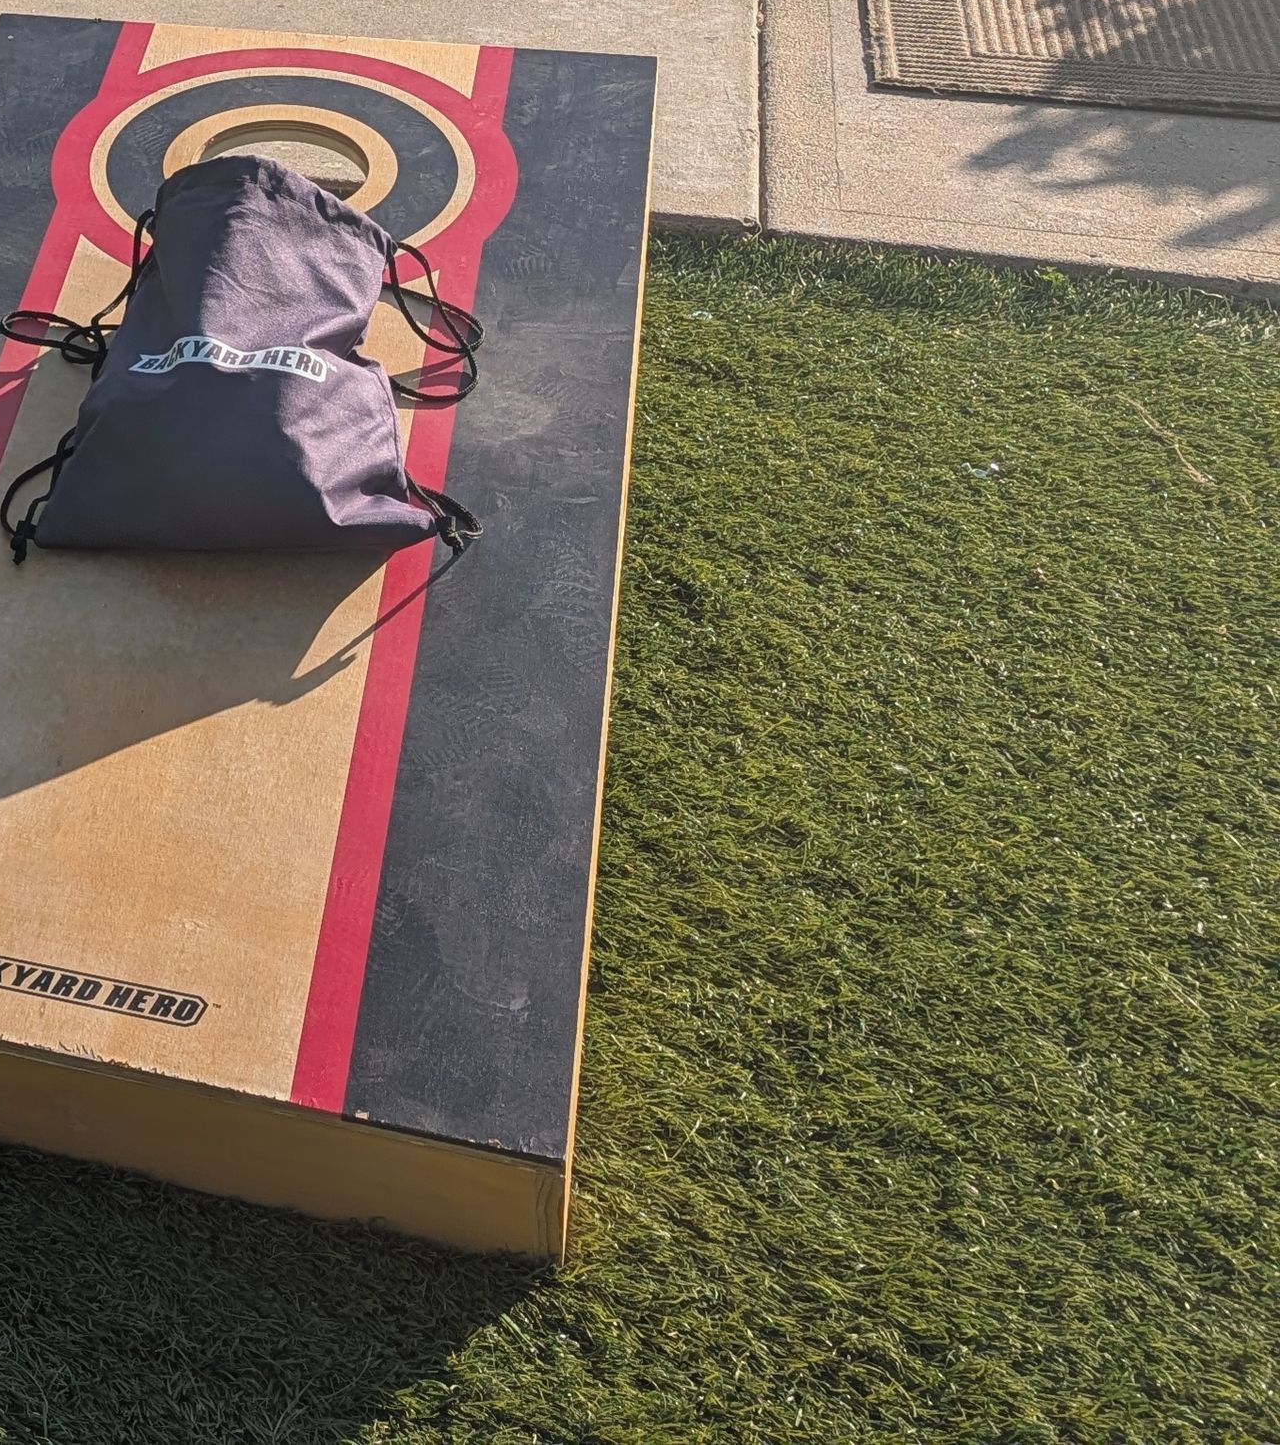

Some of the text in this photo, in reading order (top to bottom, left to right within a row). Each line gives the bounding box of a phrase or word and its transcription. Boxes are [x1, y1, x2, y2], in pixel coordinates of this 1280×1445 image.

[137, 340, 256, 371] BACKYARD
[262, 349, 324, 377] HERO
[104, 984, 201, 1022] HERO
